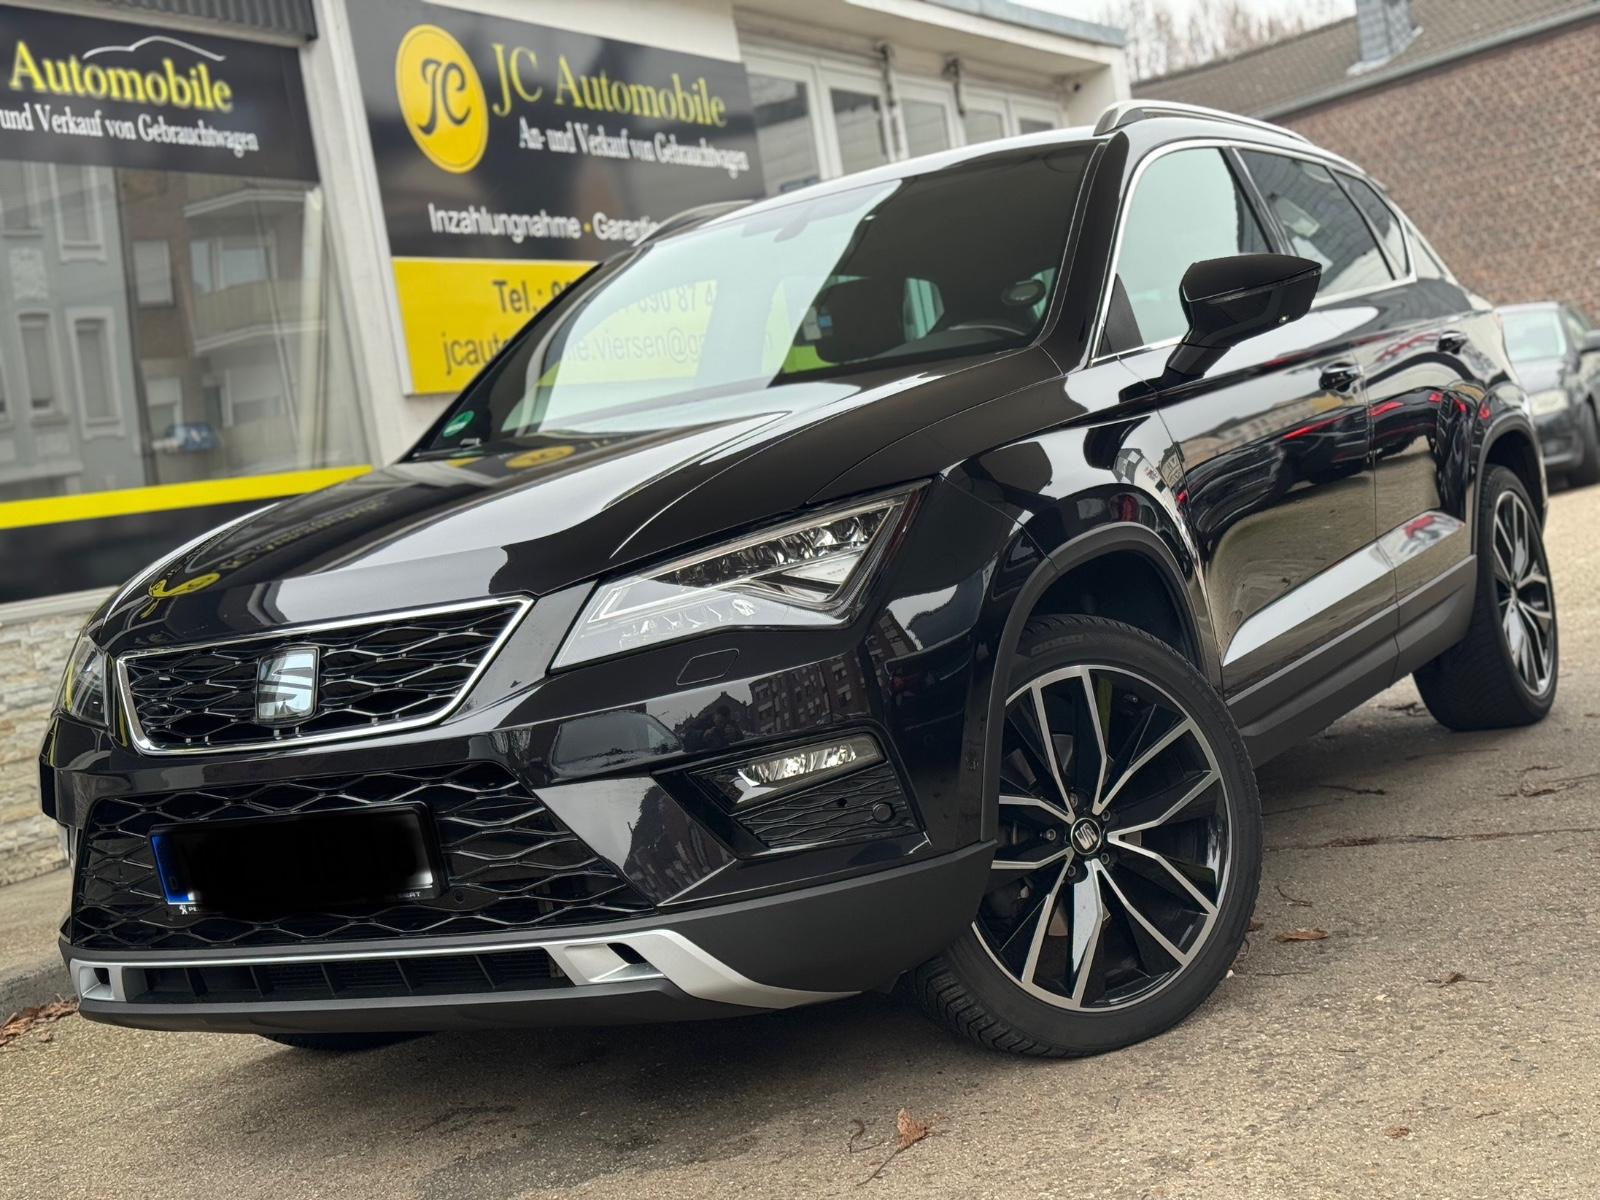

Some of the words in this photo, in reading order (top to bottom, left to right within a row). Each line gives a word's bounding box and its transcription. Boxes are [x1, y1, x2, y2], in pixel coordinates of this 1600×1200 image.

[9, 41, 233, 113] Automobile
[492, 43, 543, 117] JC
[554, 54, 728, 127] Automobile
[0, 102, 34, 131] und
[33, 104, 103, 137] Verkauf
[104, 119, 137, 140] von
[138, 113, 259, 158] Gebrauchtwagen
[545, 121, 577, 154] und
[574, 122, 631, 159] Verkauf
[629, 139, 656, 162] von
[654, 132, 750, 179] Gebrauchtwagen
[428, 202, 581, 243] Inzahlungnahme
